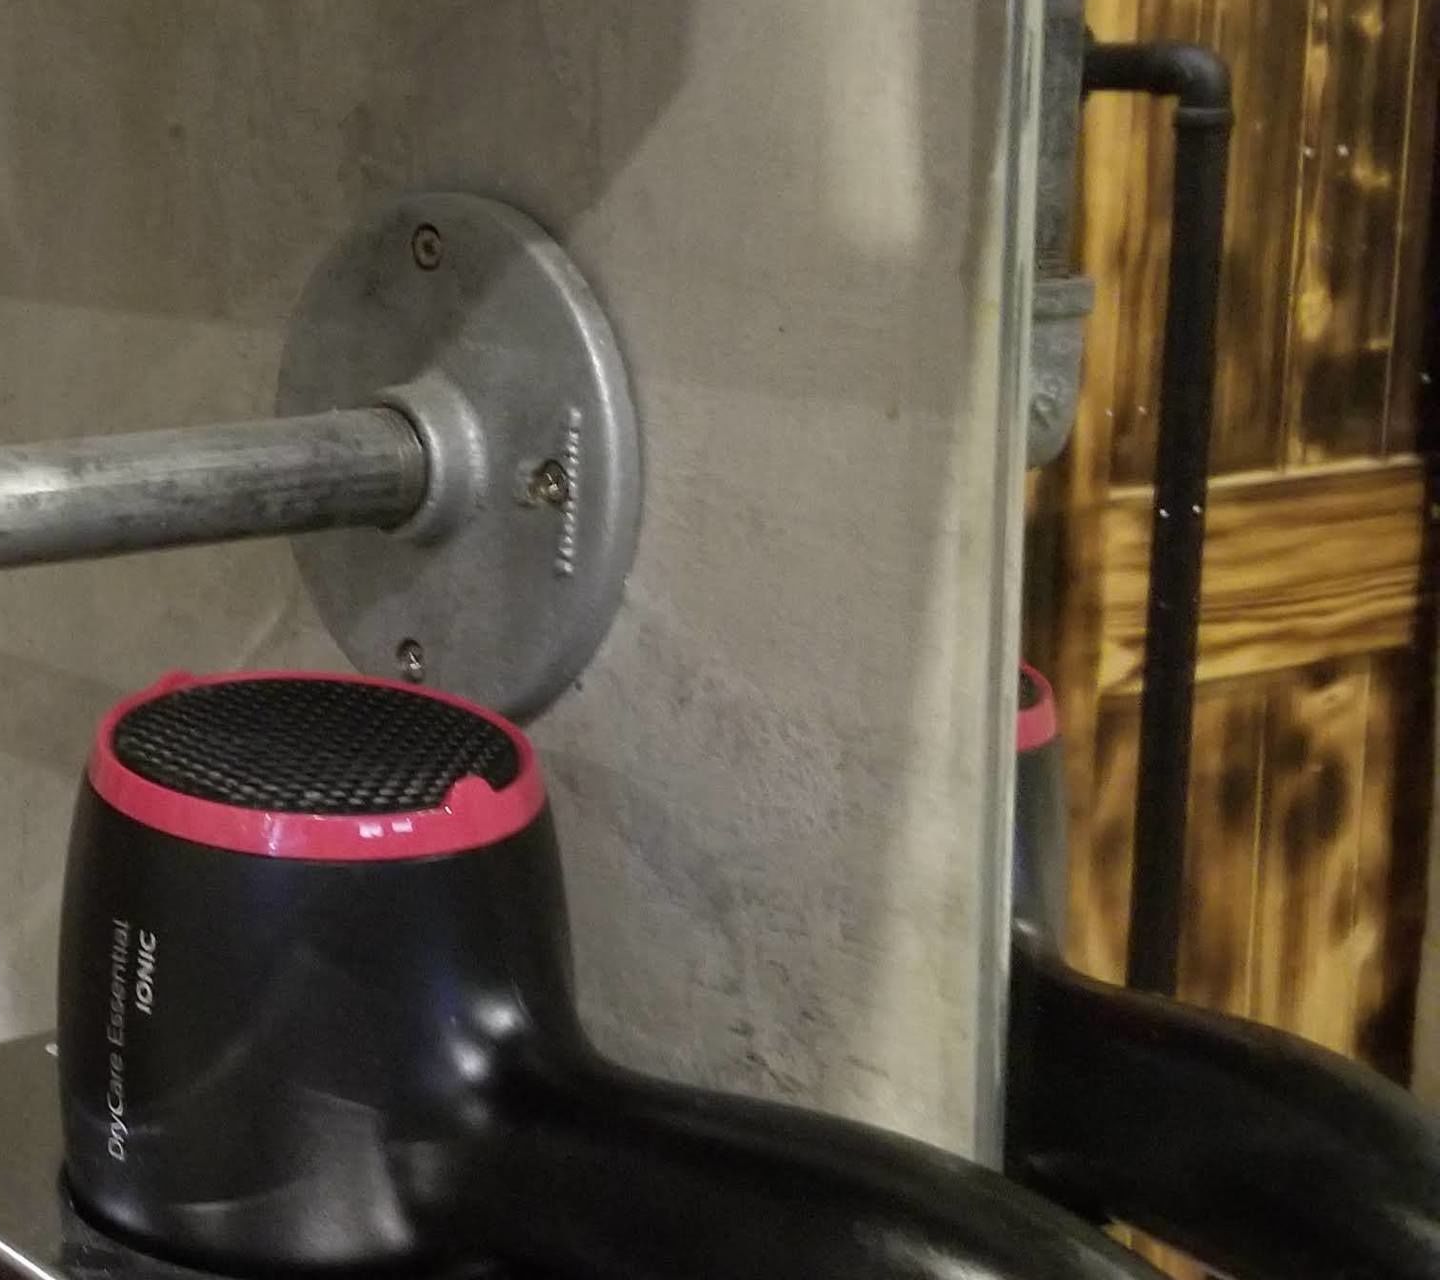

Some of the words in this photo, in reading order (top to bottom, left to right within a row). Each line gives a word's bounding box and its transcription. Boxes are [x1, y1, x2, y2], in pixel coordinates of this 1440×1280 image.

[107, 919, 130, 1047] Essential
[135, 929, 157, 1015] IONIC
[107, 1051, 129, 1162] DryCare
